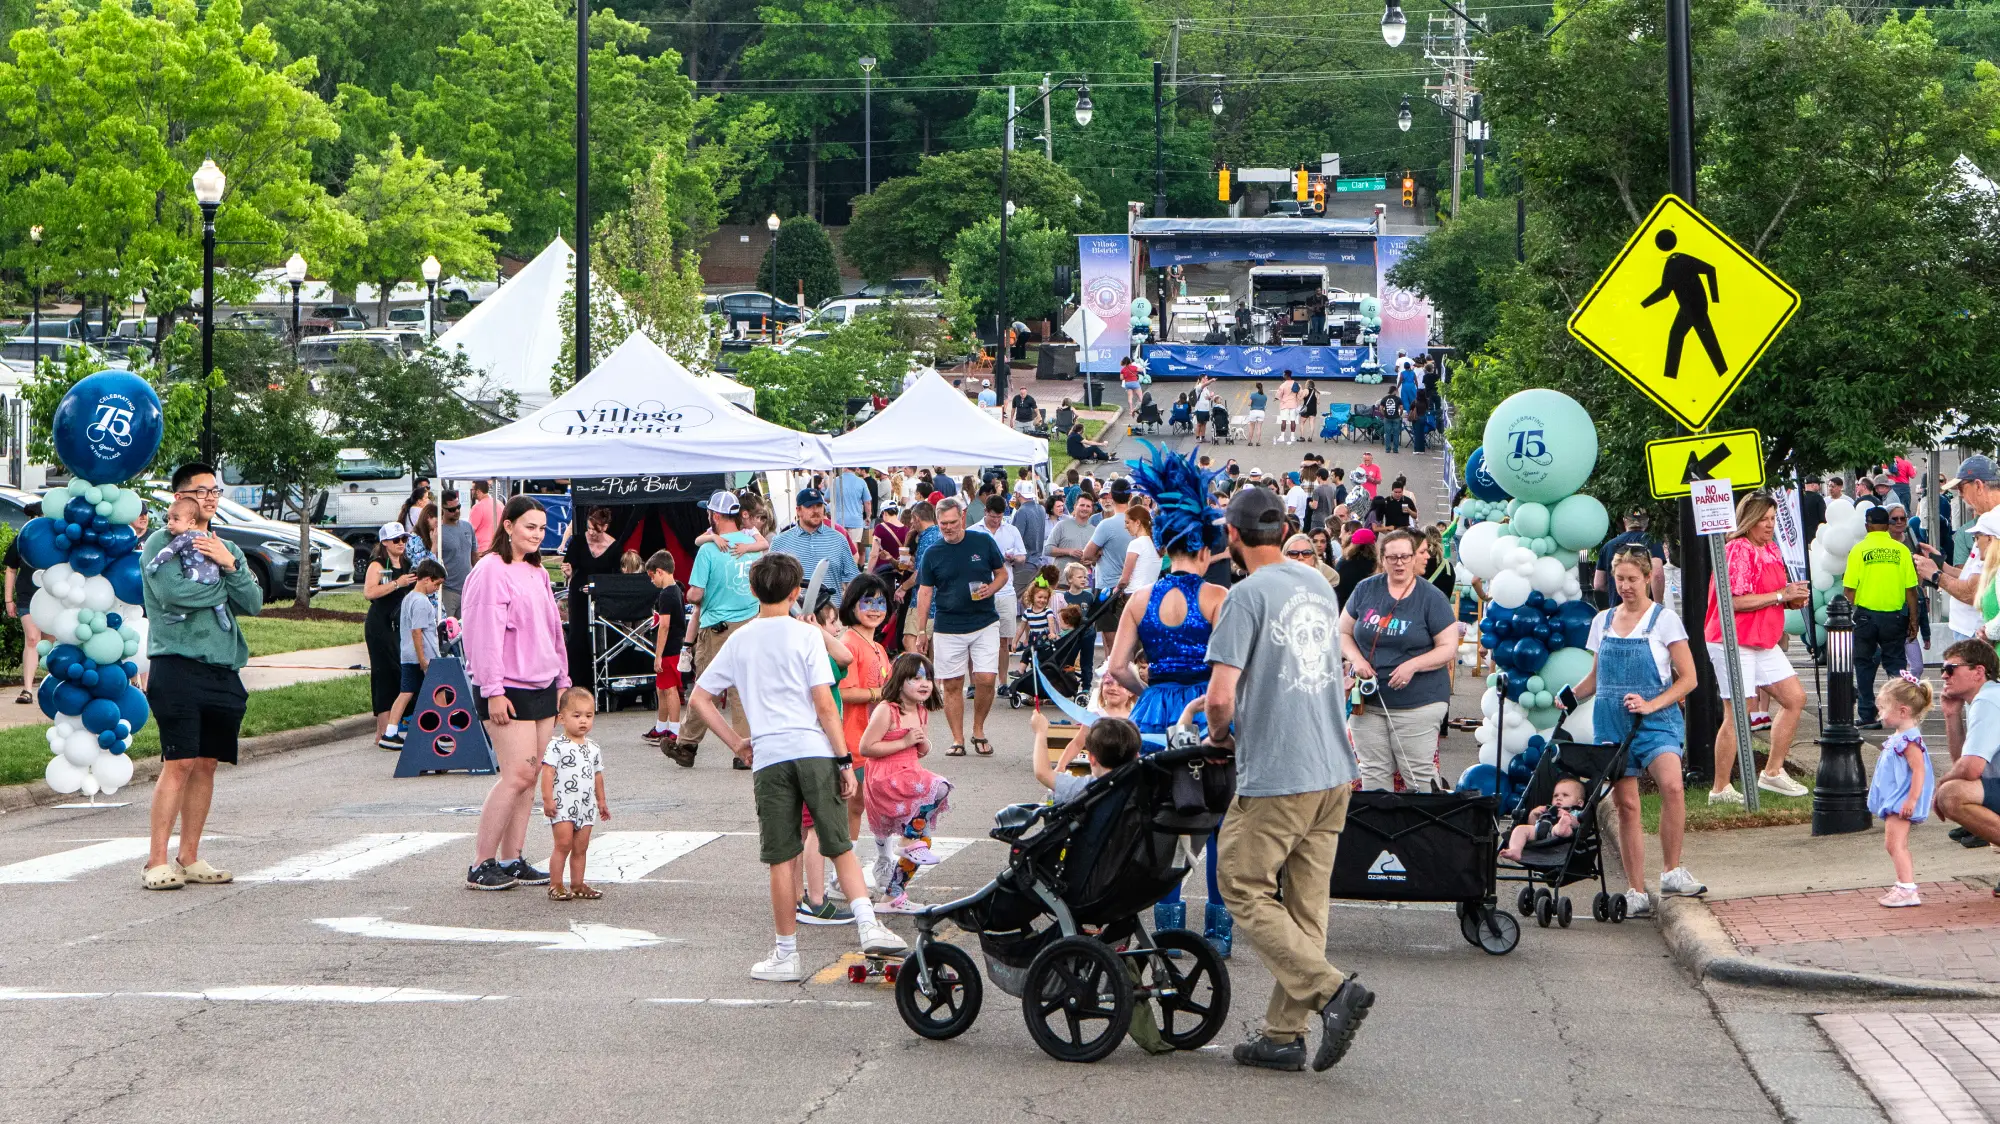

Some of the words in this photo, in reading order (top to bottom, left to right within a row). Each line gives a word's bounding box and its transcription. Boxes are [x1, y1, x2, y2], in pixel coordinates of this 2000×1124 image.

[1341, 253, 1356, 262] york
[1099, 348, 1112, 360] 75
[1244, 365, 1272, 376] SPONSORS
[1340, 366, 1355, 374] york
[98, 393, 136, 411] CELEBRATING
[95, 404, 134, 436] 75
[1508, 415, 1545, 431] CELEBRATING
[566, 424, 683, 436] District
[1508, 430, 1546, 458] 75
[102, 451, 121, 460] VILLAGE
[602, 477, 638, 495] Photo
[642, 475, 692, 493] Booth
[1705, 484, 1717, 495] NO
[1695, 493, 1730, 505] PARKING
[1701, 518, 1730, 528] POLICE
[1873, 547, 1901, 555] CAROLINA
